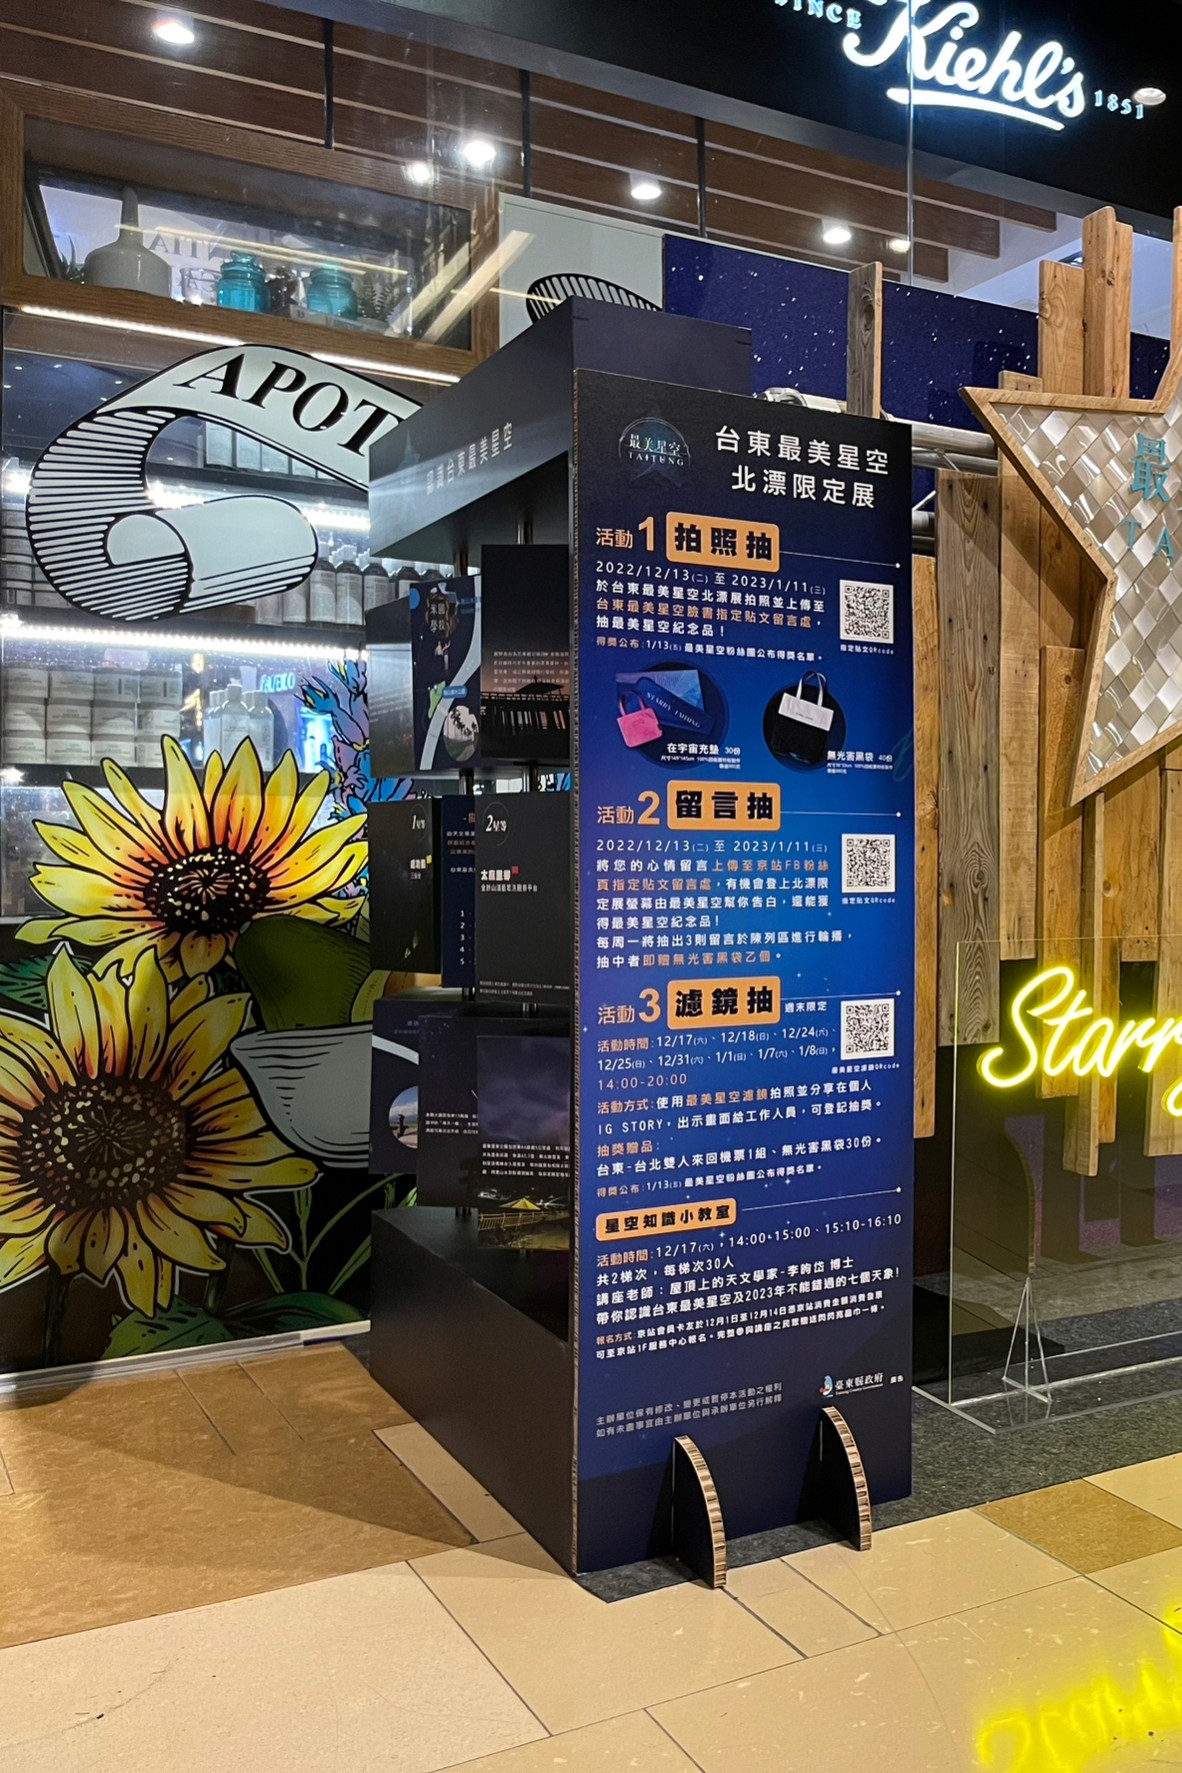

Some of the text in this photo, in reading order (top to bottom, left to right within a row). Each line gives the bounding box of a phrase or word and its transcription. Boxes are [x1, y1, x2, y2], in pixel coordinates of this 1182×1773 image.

[843, 0, 1085, 117] Kiehl's
[1094, 90, 1144, 119] 1851
[629, 434, 681, 458] 最美星空
[629, 453, 684, 466] TAITUNG
[715, 426, 889, 475] 台東最美星空
[731, 465, 875, 508] 北漂限定展
[596, 516, 772, 561] 活動 1 拍照抽
[714, 572, 726, 585] 至
[596, 580, 825, 613] 於台東最美星空北漂展拍照並上傳至
[597, 790, 773, 825] 活動 2 留言抽
[714, 840, 726, 852] 至
[597, 986, 827, 1025] 活動 3 濾鏡抽 週末限定
[598, 1073, 688, 1091] 14:00-20:00
[605, 1204, 730, 1234] 星空知識小教室
[830, 1256, 854, 1272] 博士
